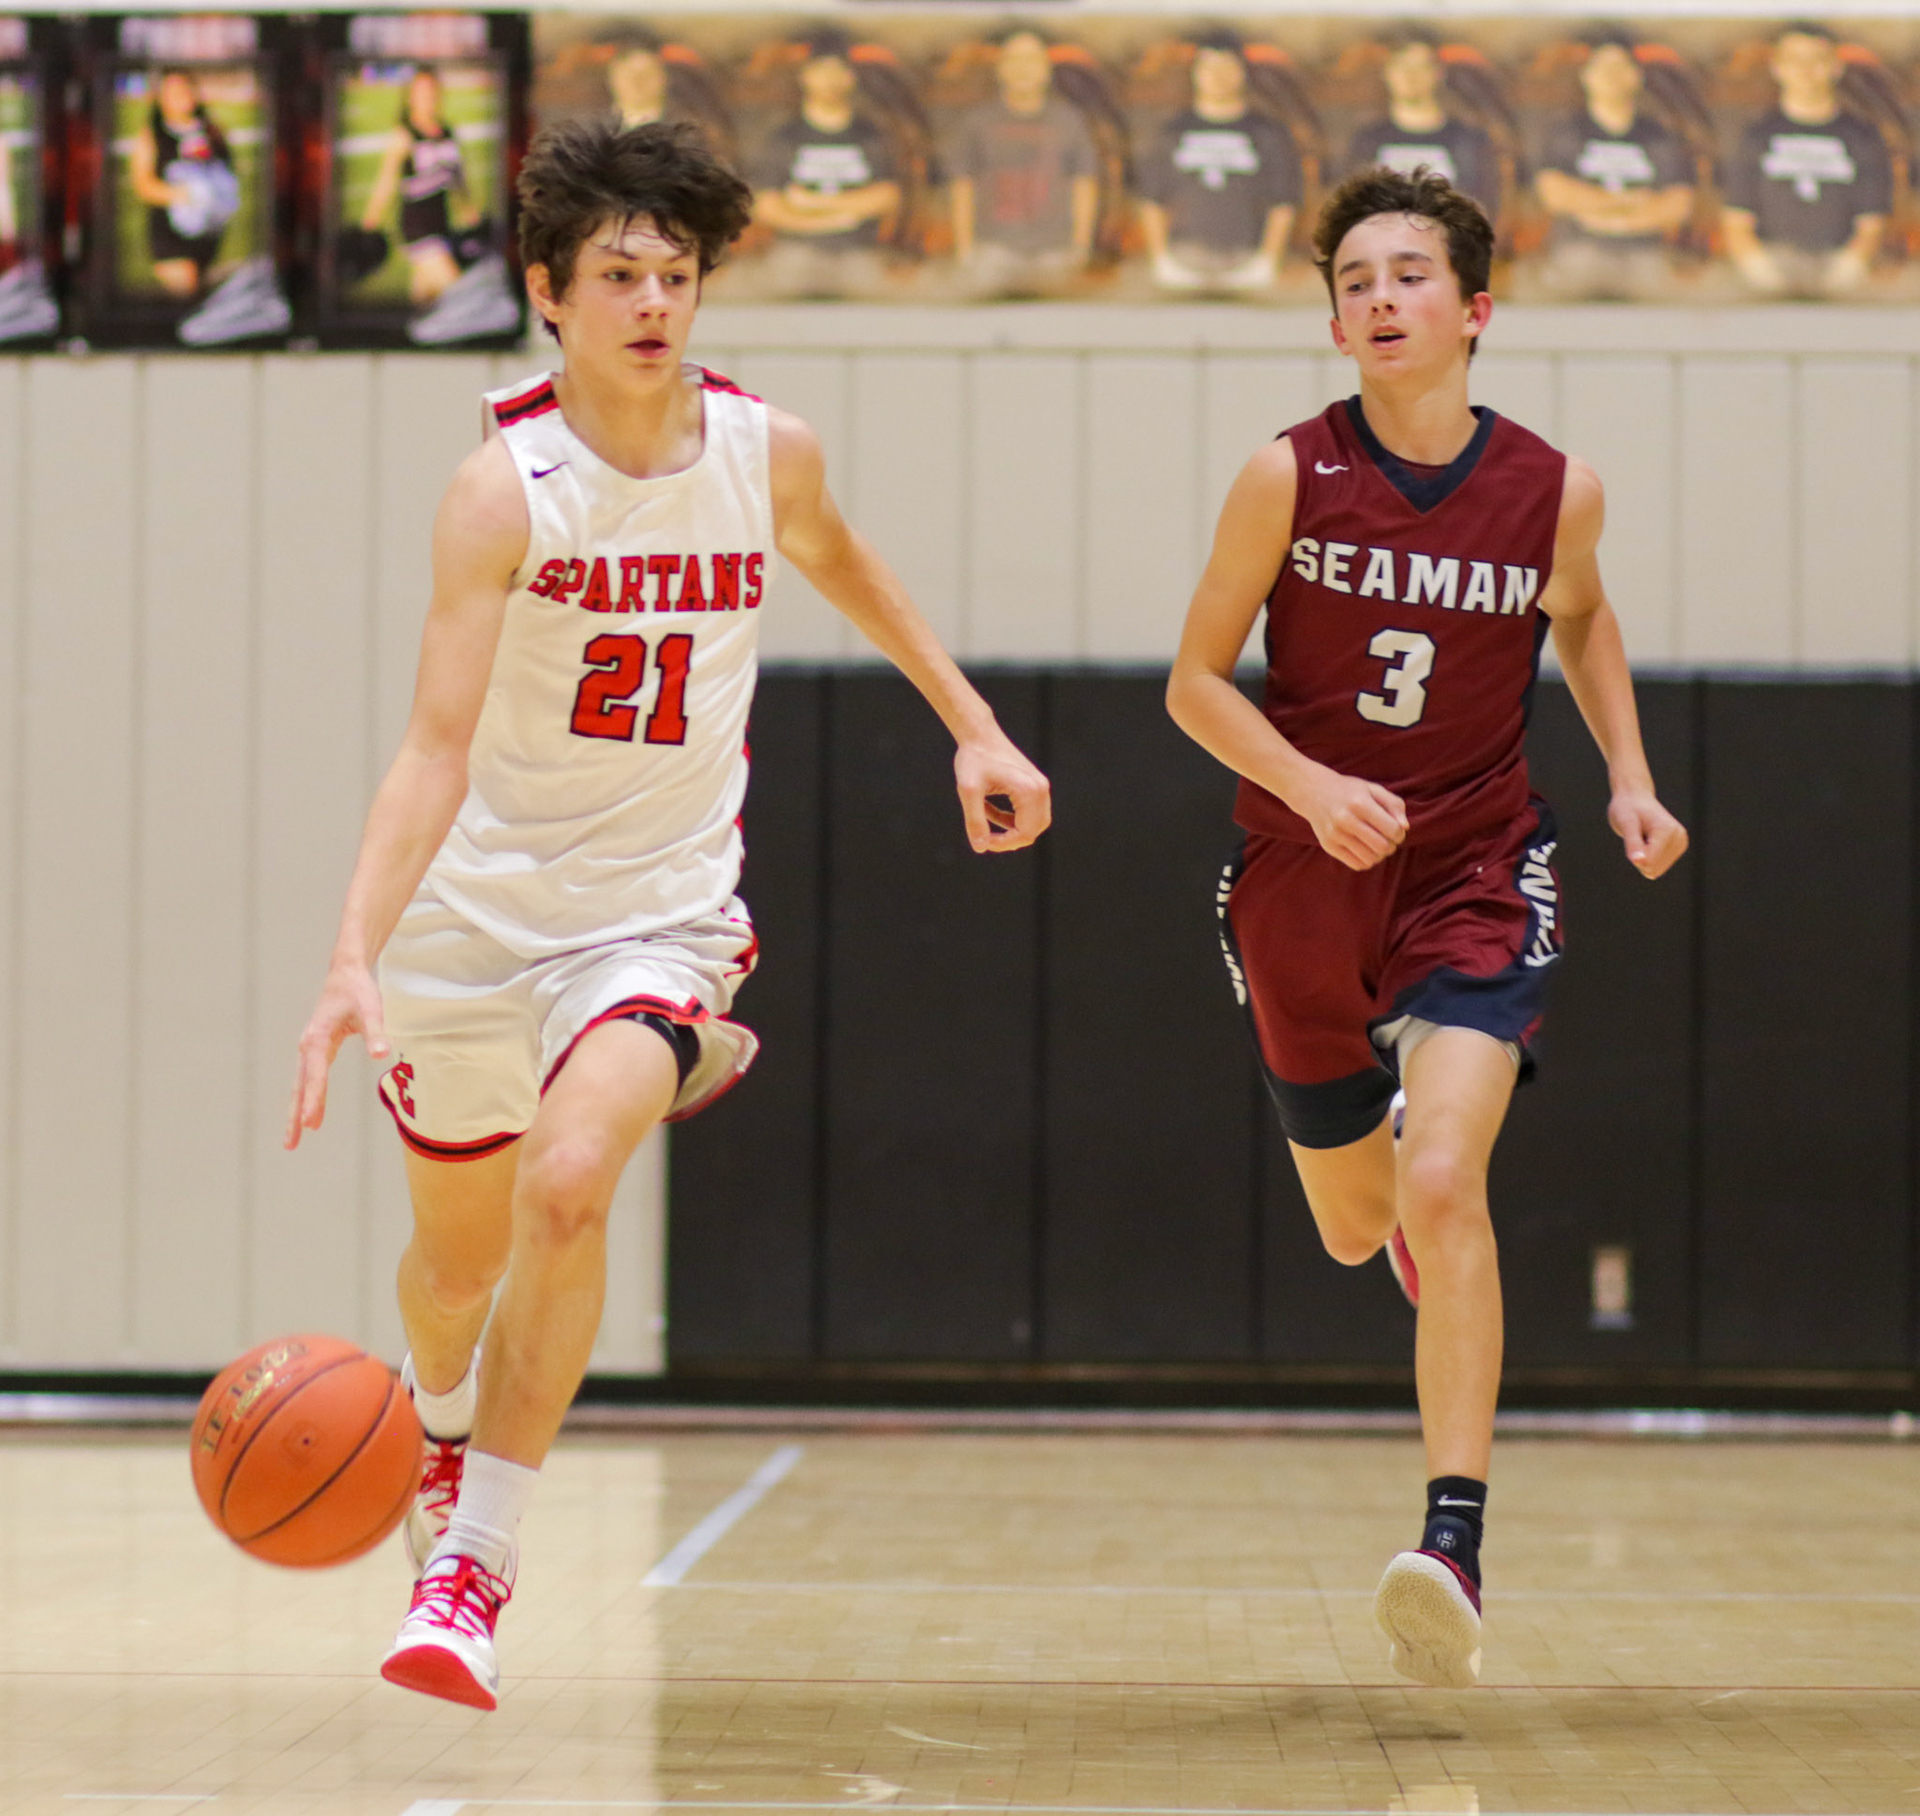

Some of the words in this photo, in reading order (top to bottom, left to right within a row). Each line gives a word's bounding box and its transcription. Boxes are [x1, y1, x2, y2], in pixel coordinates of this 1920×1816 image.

[526, 552, 764, 614] SPARTANS
[1291, 536, 1539, 616] SEAMAN
[569, 633, 694, 746] 21
[1356, 626, 1436, 730] 3
